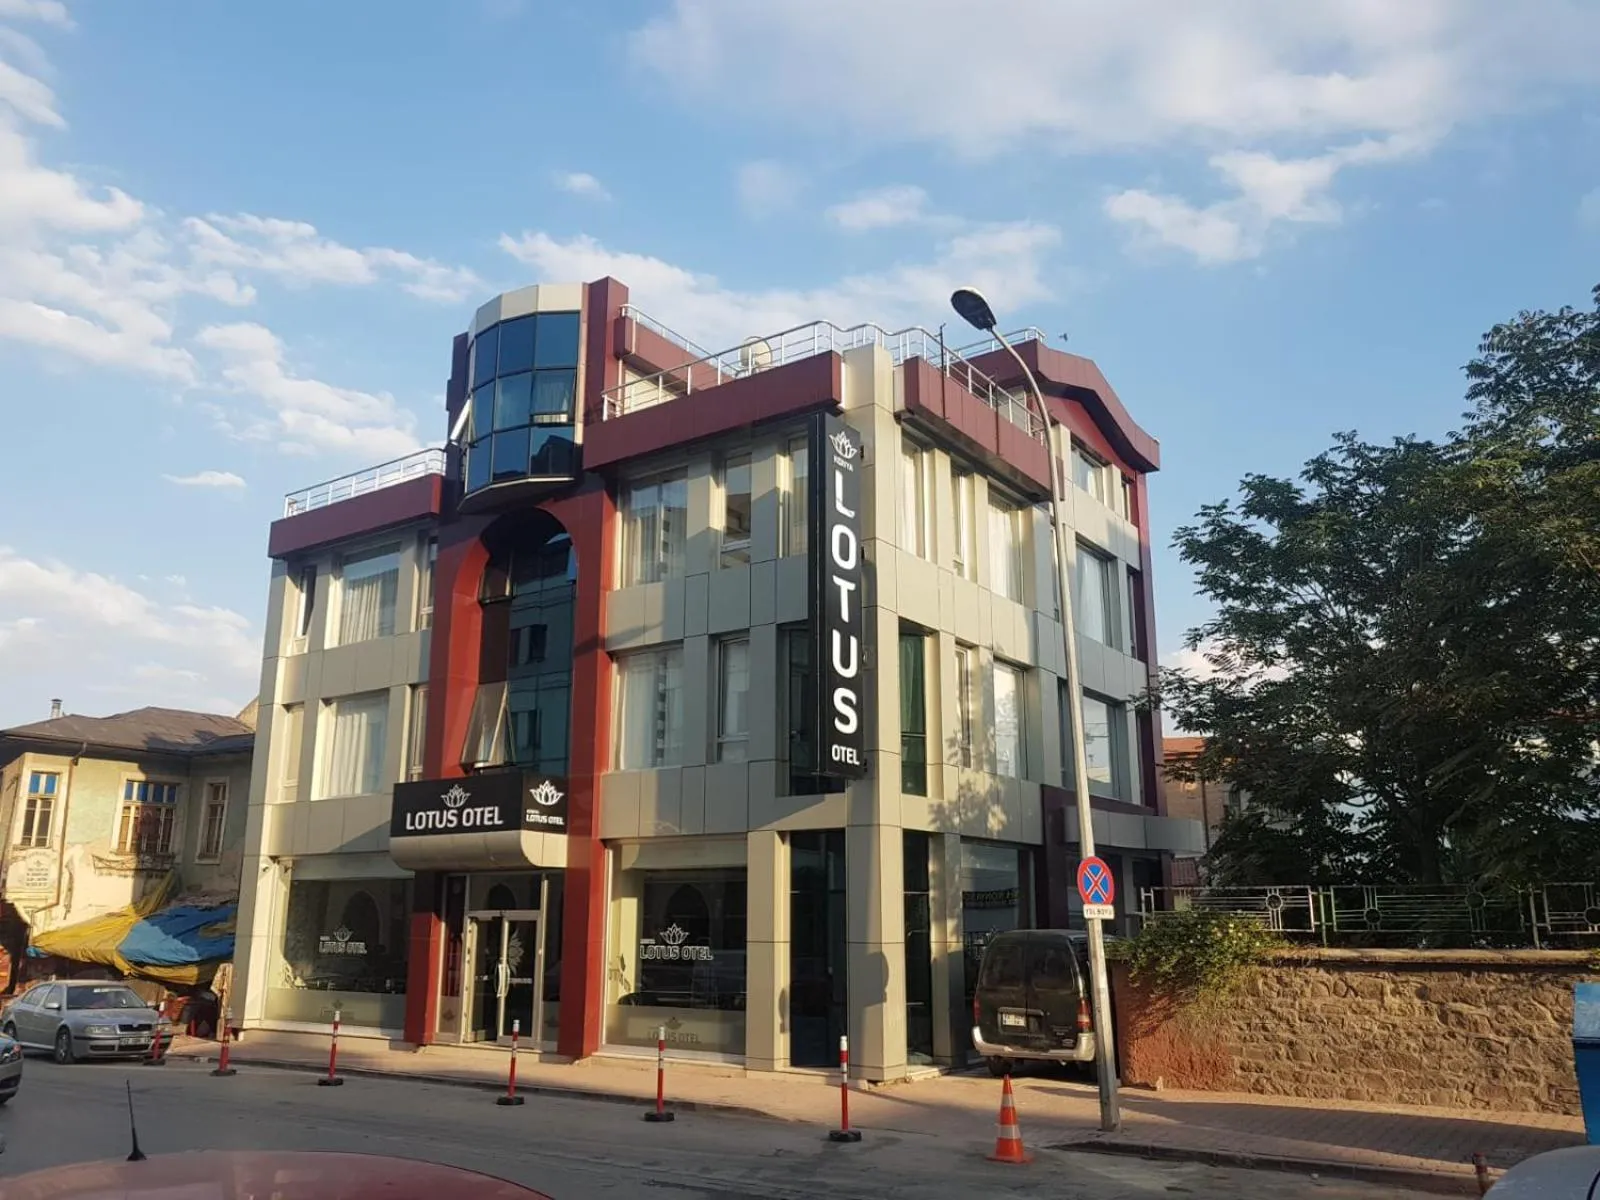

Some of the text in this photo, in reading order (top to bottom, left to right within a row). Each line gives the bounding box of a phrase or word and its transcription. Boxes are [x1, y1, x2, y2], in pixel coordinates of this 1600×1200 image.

[832, 469, 858, 735] LOTUS
[831, 744, 860, 765] OTEL
[405, 806, 504, 830] LOTUS OTEL
[525, 814, 565, 826] LOTUS OTEL
[319, 941, 368, 955] LOTUS OTEL
[639, 945, 714, 961] LOTUS OTEL
[647, 1030, 677, 1042] LOUS
